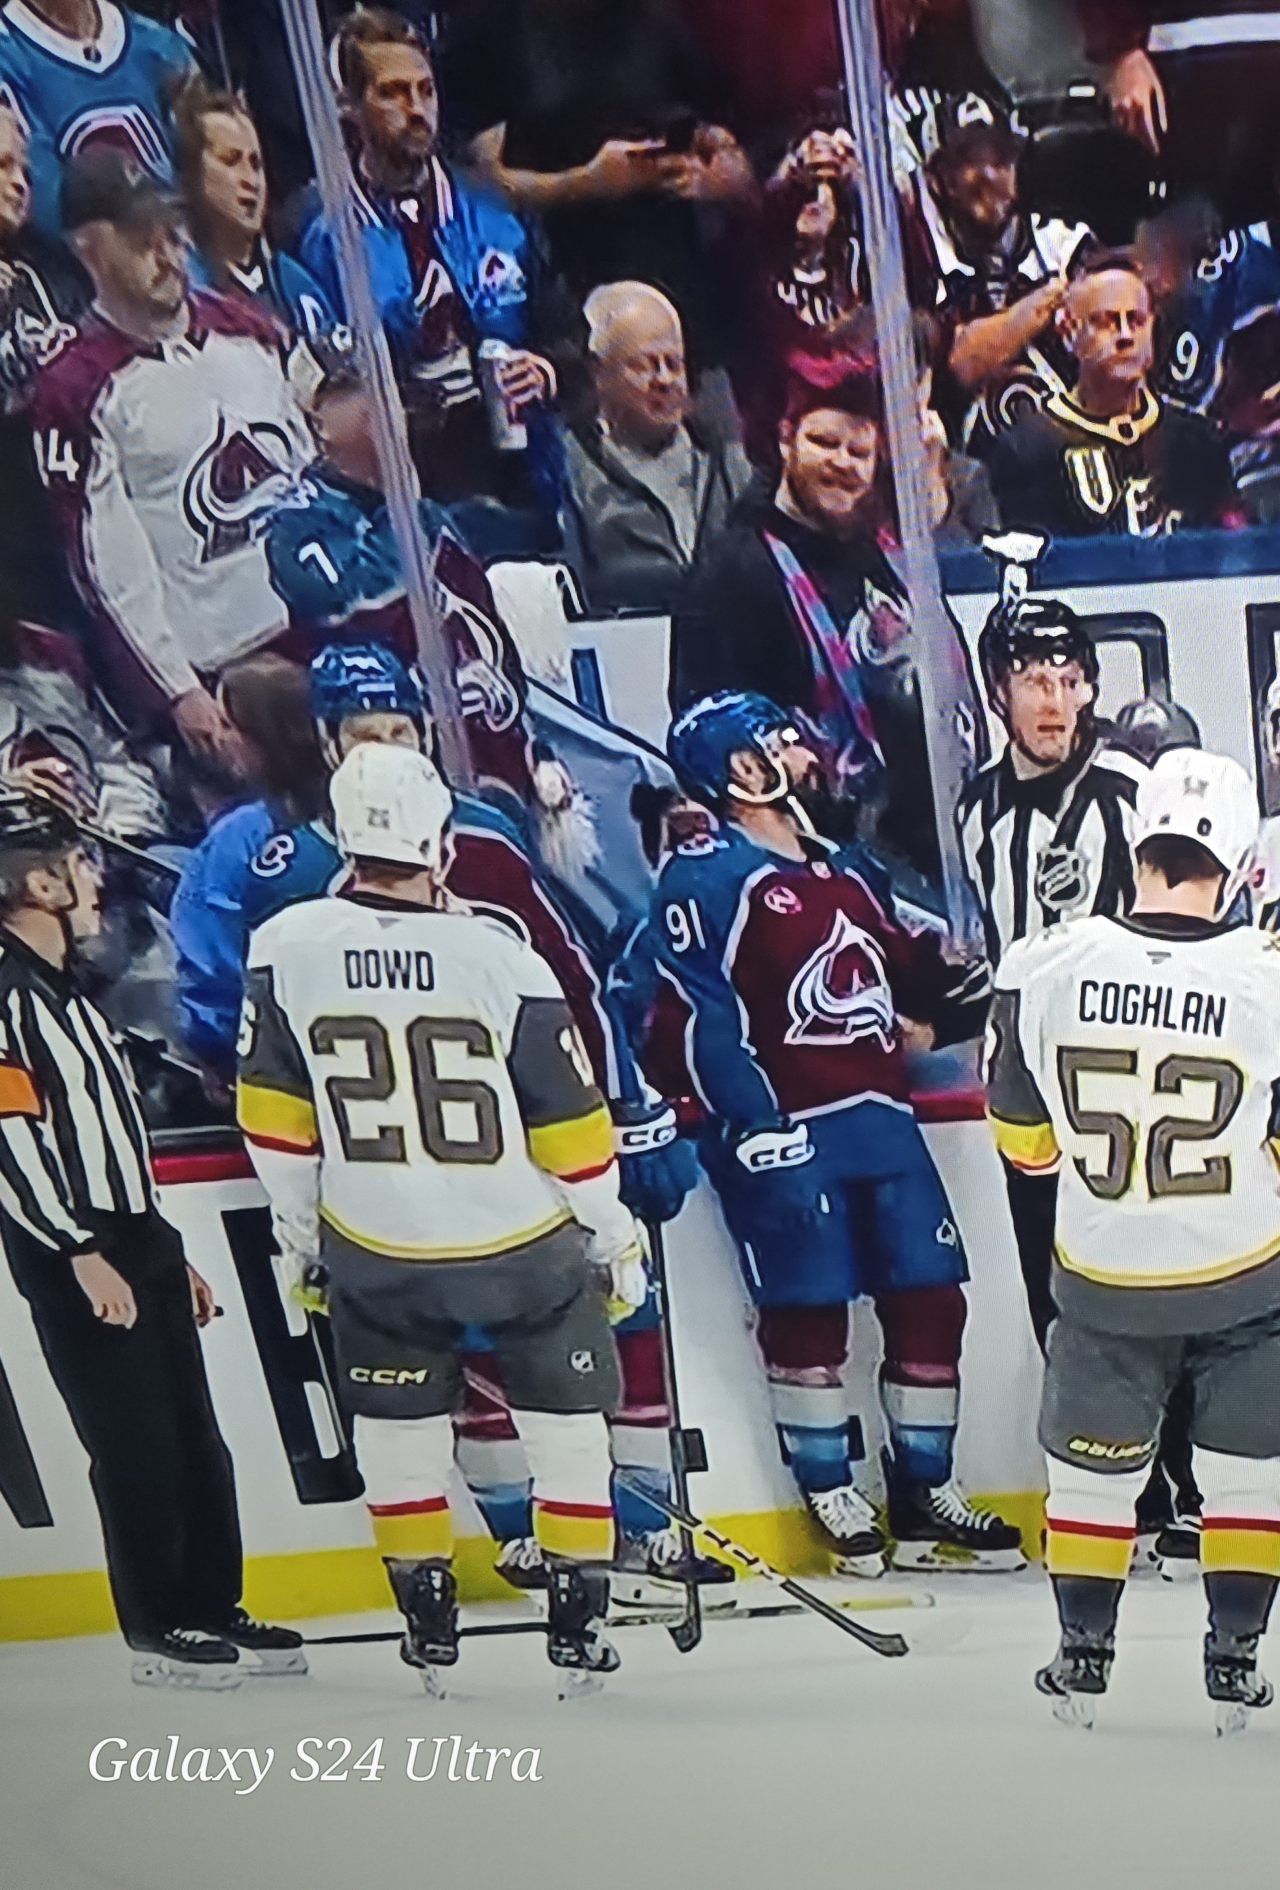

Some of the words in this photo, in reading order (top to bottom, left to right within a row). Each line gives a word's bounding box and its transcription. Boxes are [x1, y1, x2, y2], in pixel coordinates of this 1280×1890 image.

[665, 898, 706, 953] 91
[344, 949, 435, 992] DOWD
[1079, 979, 1226, 1037] COGHLAN
[308, 1014, 504, 1164] 26
[1056, 1045, 1244, 1200] 52
[349, 1366, 428, 1385] CCM
